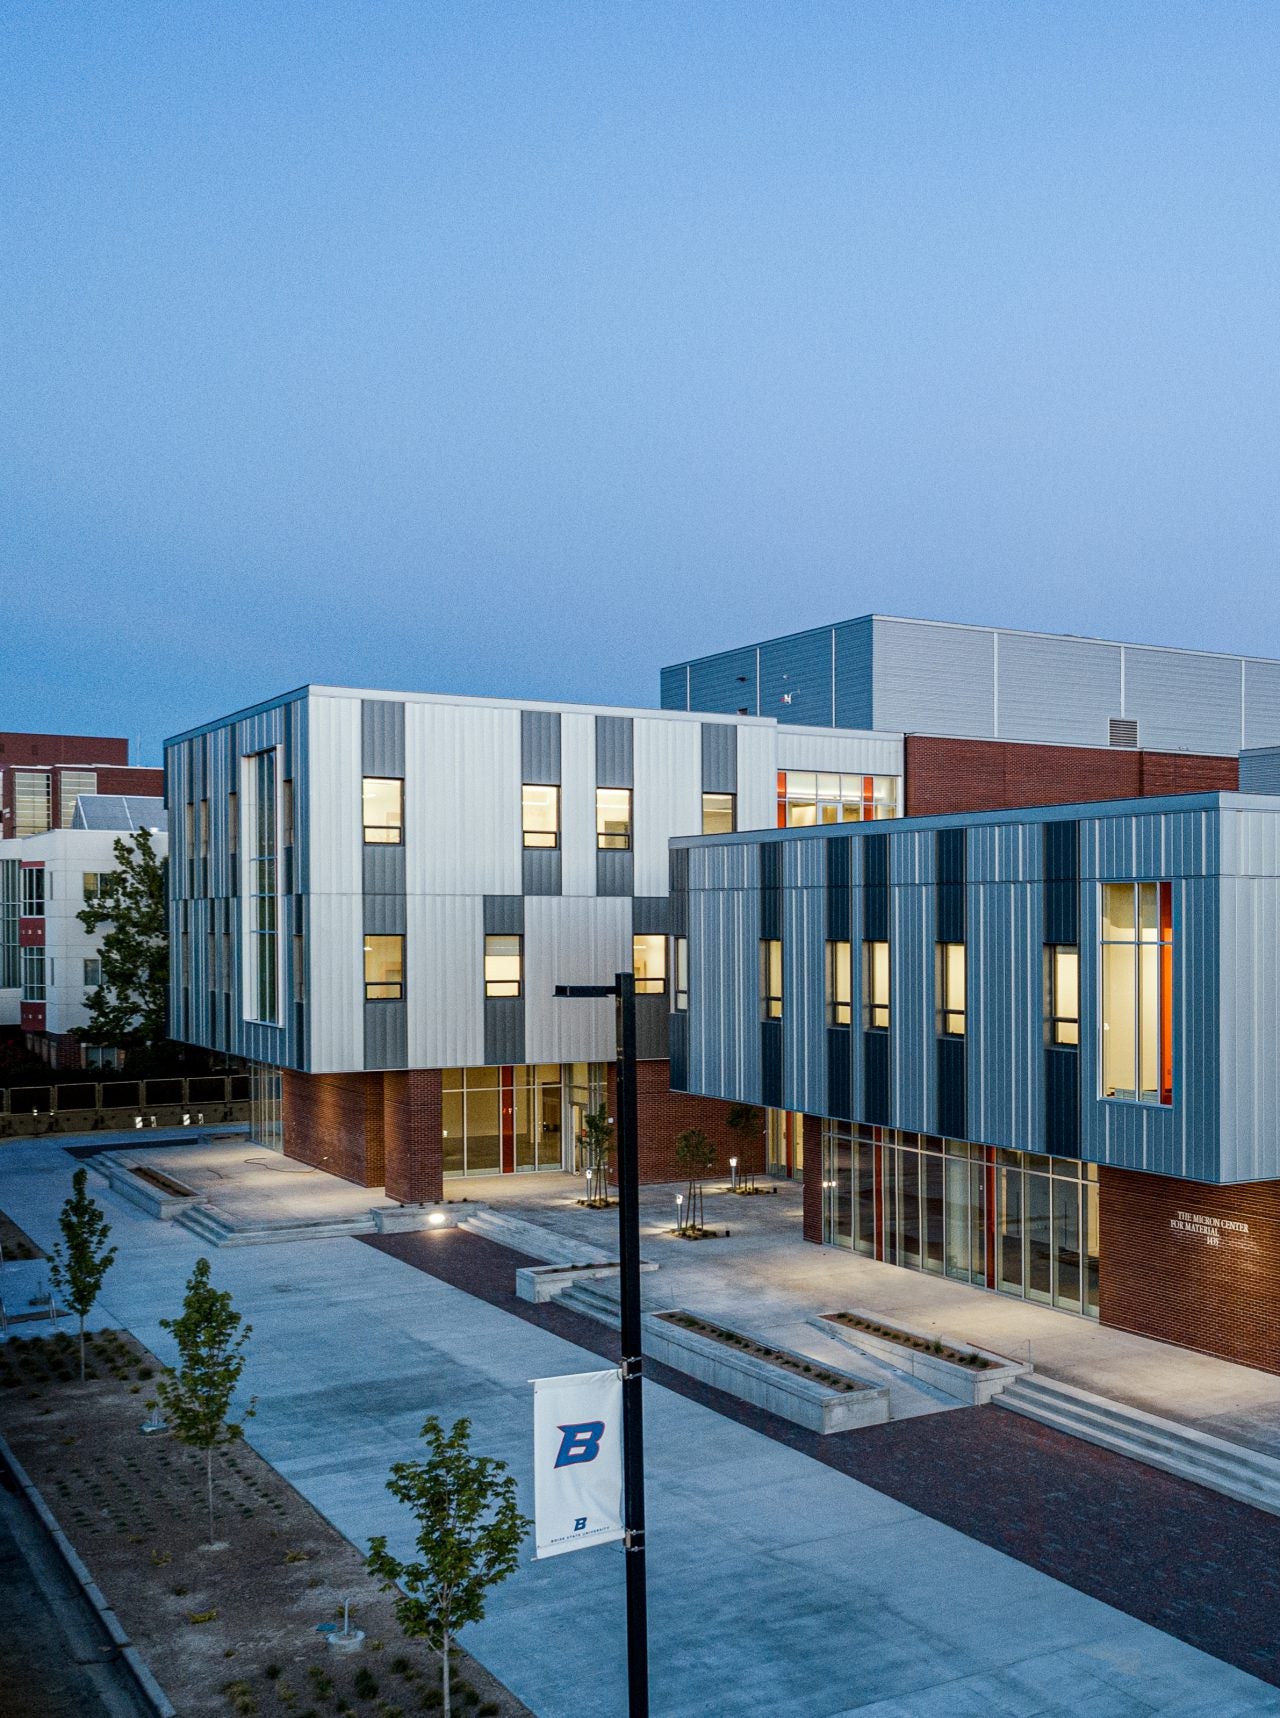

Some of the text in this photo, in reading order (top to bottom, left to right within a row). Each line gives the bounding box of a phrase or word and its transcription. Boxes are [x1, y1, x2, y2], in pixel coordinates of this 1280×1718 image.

[1170, 1219, 1220, 1237] FOR MATERIAL
[1177, 1211, 1249, 1233] THE MICRON CENTER
[554, 1420, 606, 1470] B
[574, 1516, 587, 1531] B
